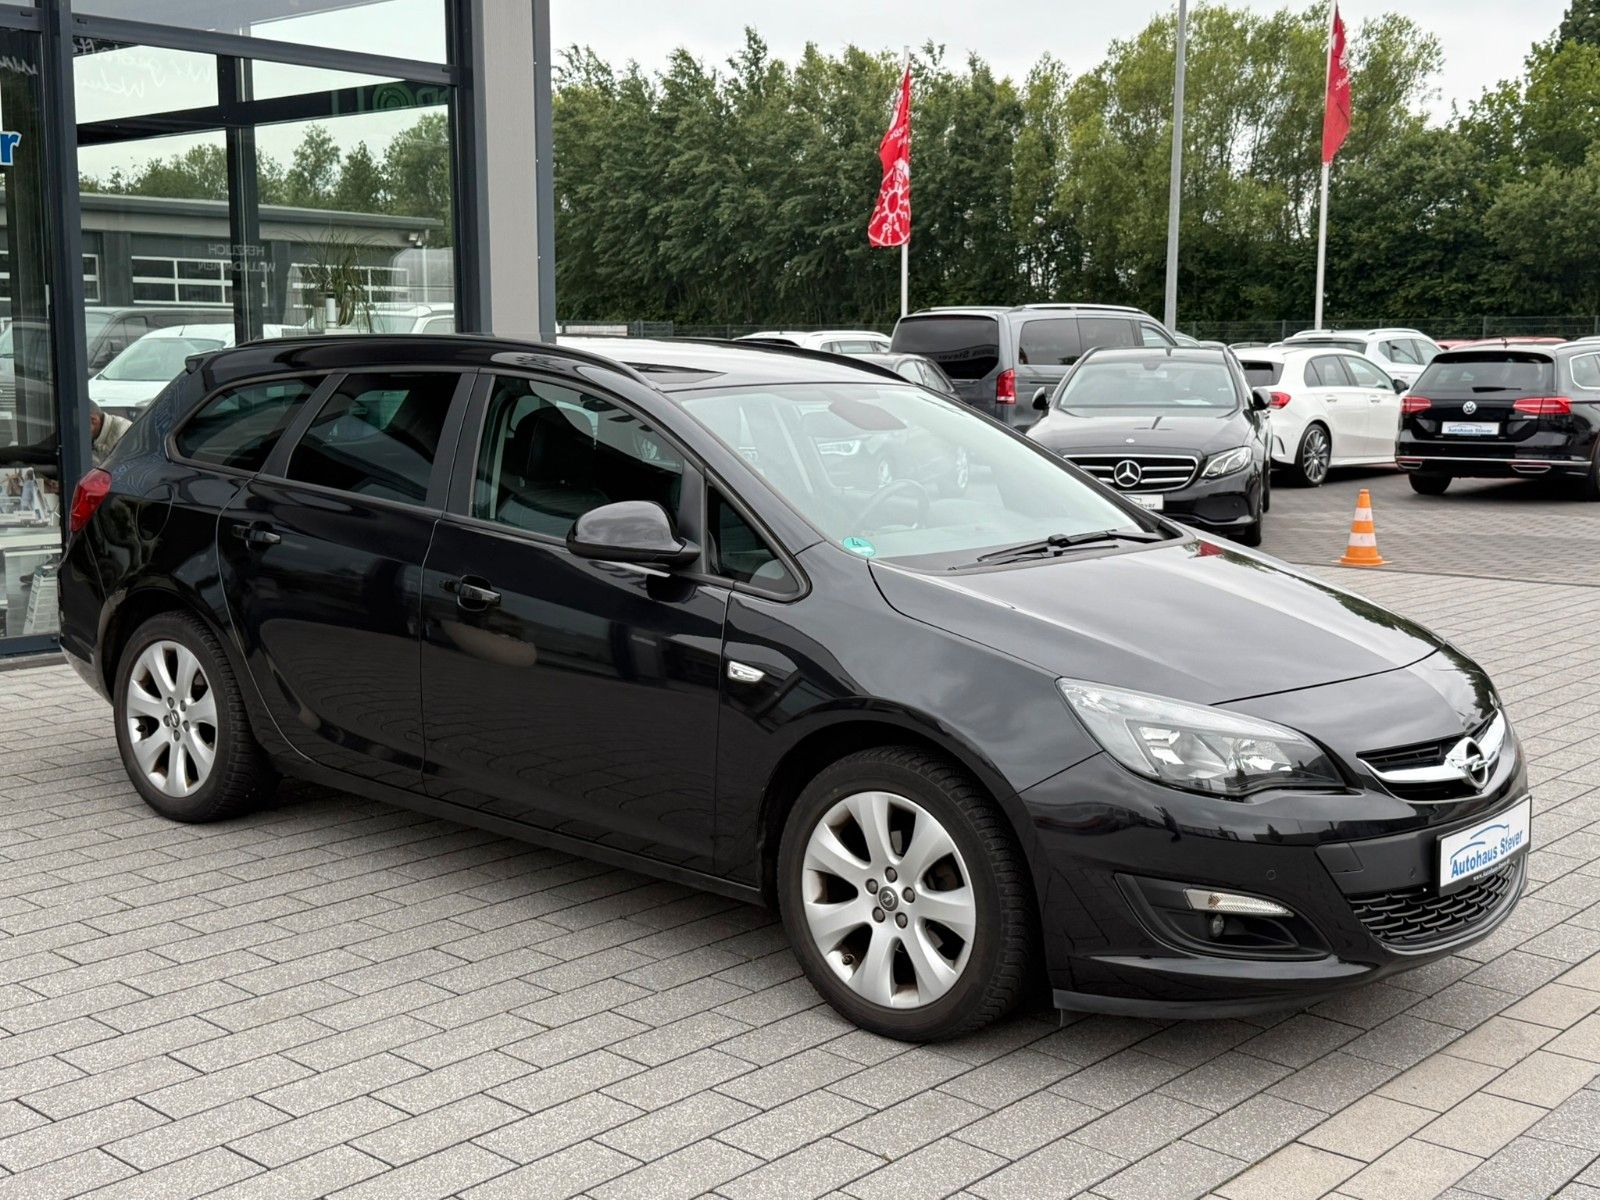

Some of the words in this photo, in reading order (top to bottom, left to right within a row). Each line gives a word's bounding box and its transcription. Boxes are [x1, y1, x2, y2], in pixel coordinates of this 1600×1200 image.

[851, 537, 862, 547] 4
[1451, 846, 1498, 879] Autohaus
[1500, 830, 1523, 855] Stever
